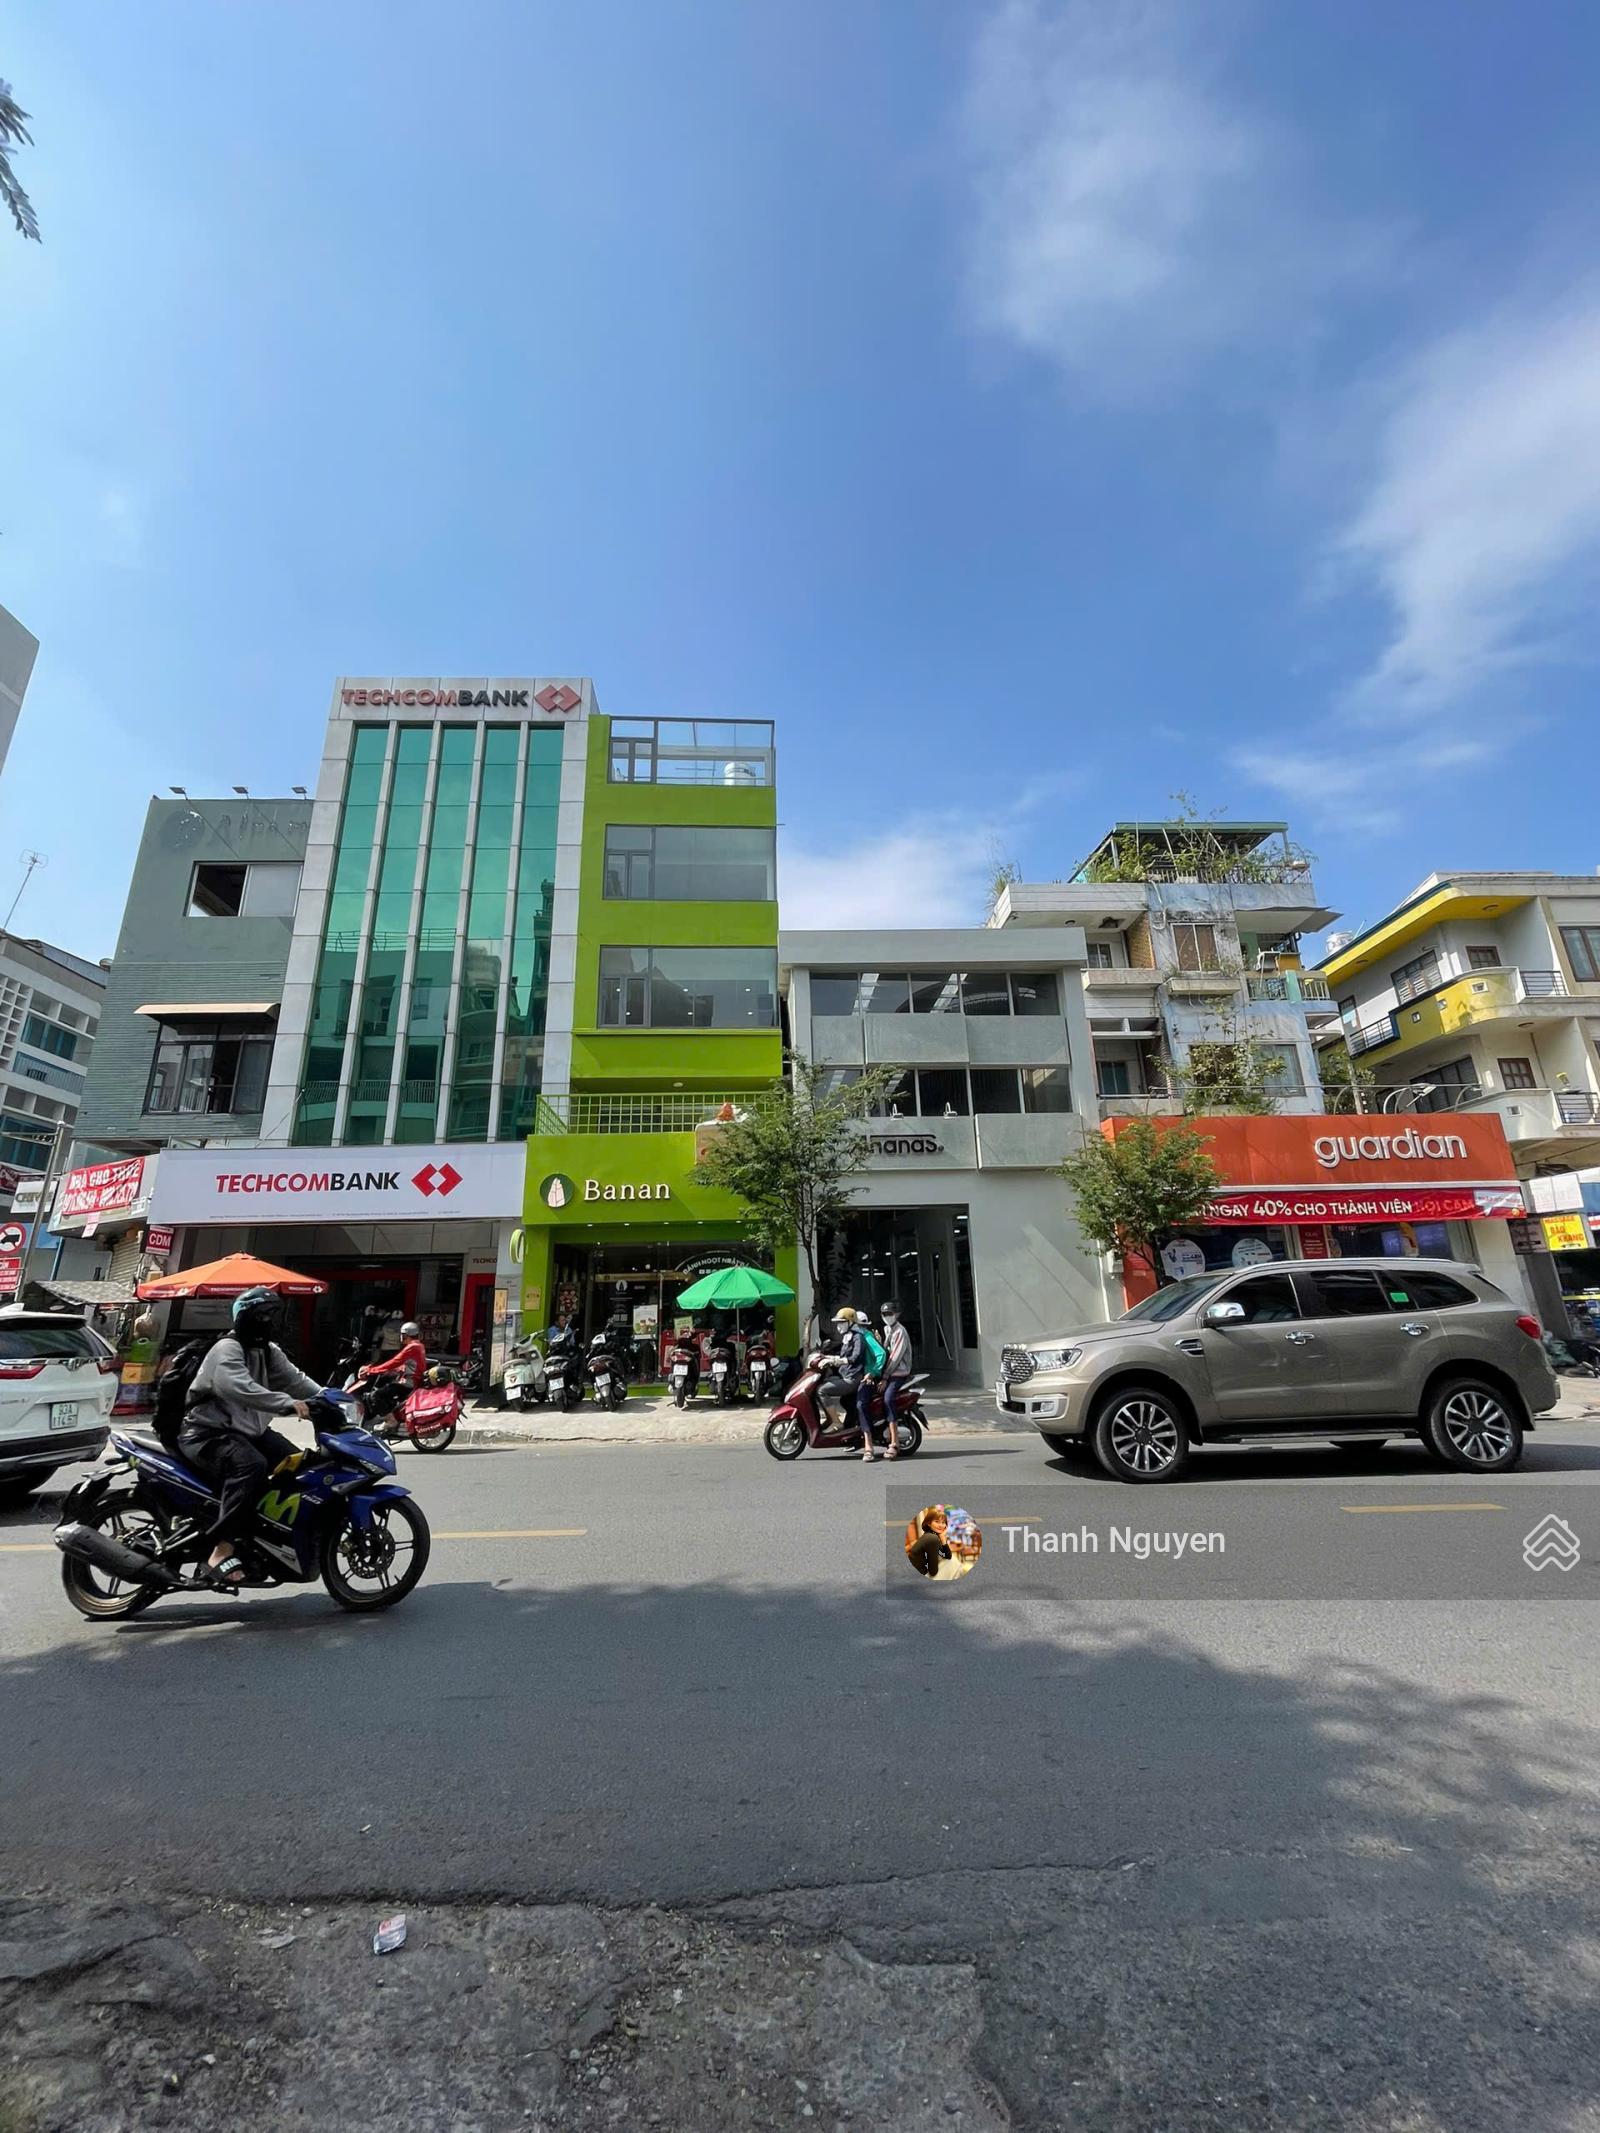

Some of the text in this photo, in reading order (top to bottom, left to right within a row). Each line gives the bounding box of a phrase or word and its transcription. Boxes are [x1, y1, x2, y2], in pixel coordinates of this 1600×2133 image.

[341, 688, 528, 707] TECHCOMBANK
[1313, 1127, 1467, 1169] guardian
[216, 1171, 401, 1193] TECHCOMBANK
[584, 1178, 670, 1201] Banan
[1210, 1204, 1249, 1217] NGAY
[1253, 1200, 1292, 1216] 40%
[1293, 1203, 1327, 1215] CHO
[1330, 1198, 1378, 1215] THÀNH
[1383, 1198, 1413, 1214] VIÊN
[149, 1233, 172, 1247] CDM
